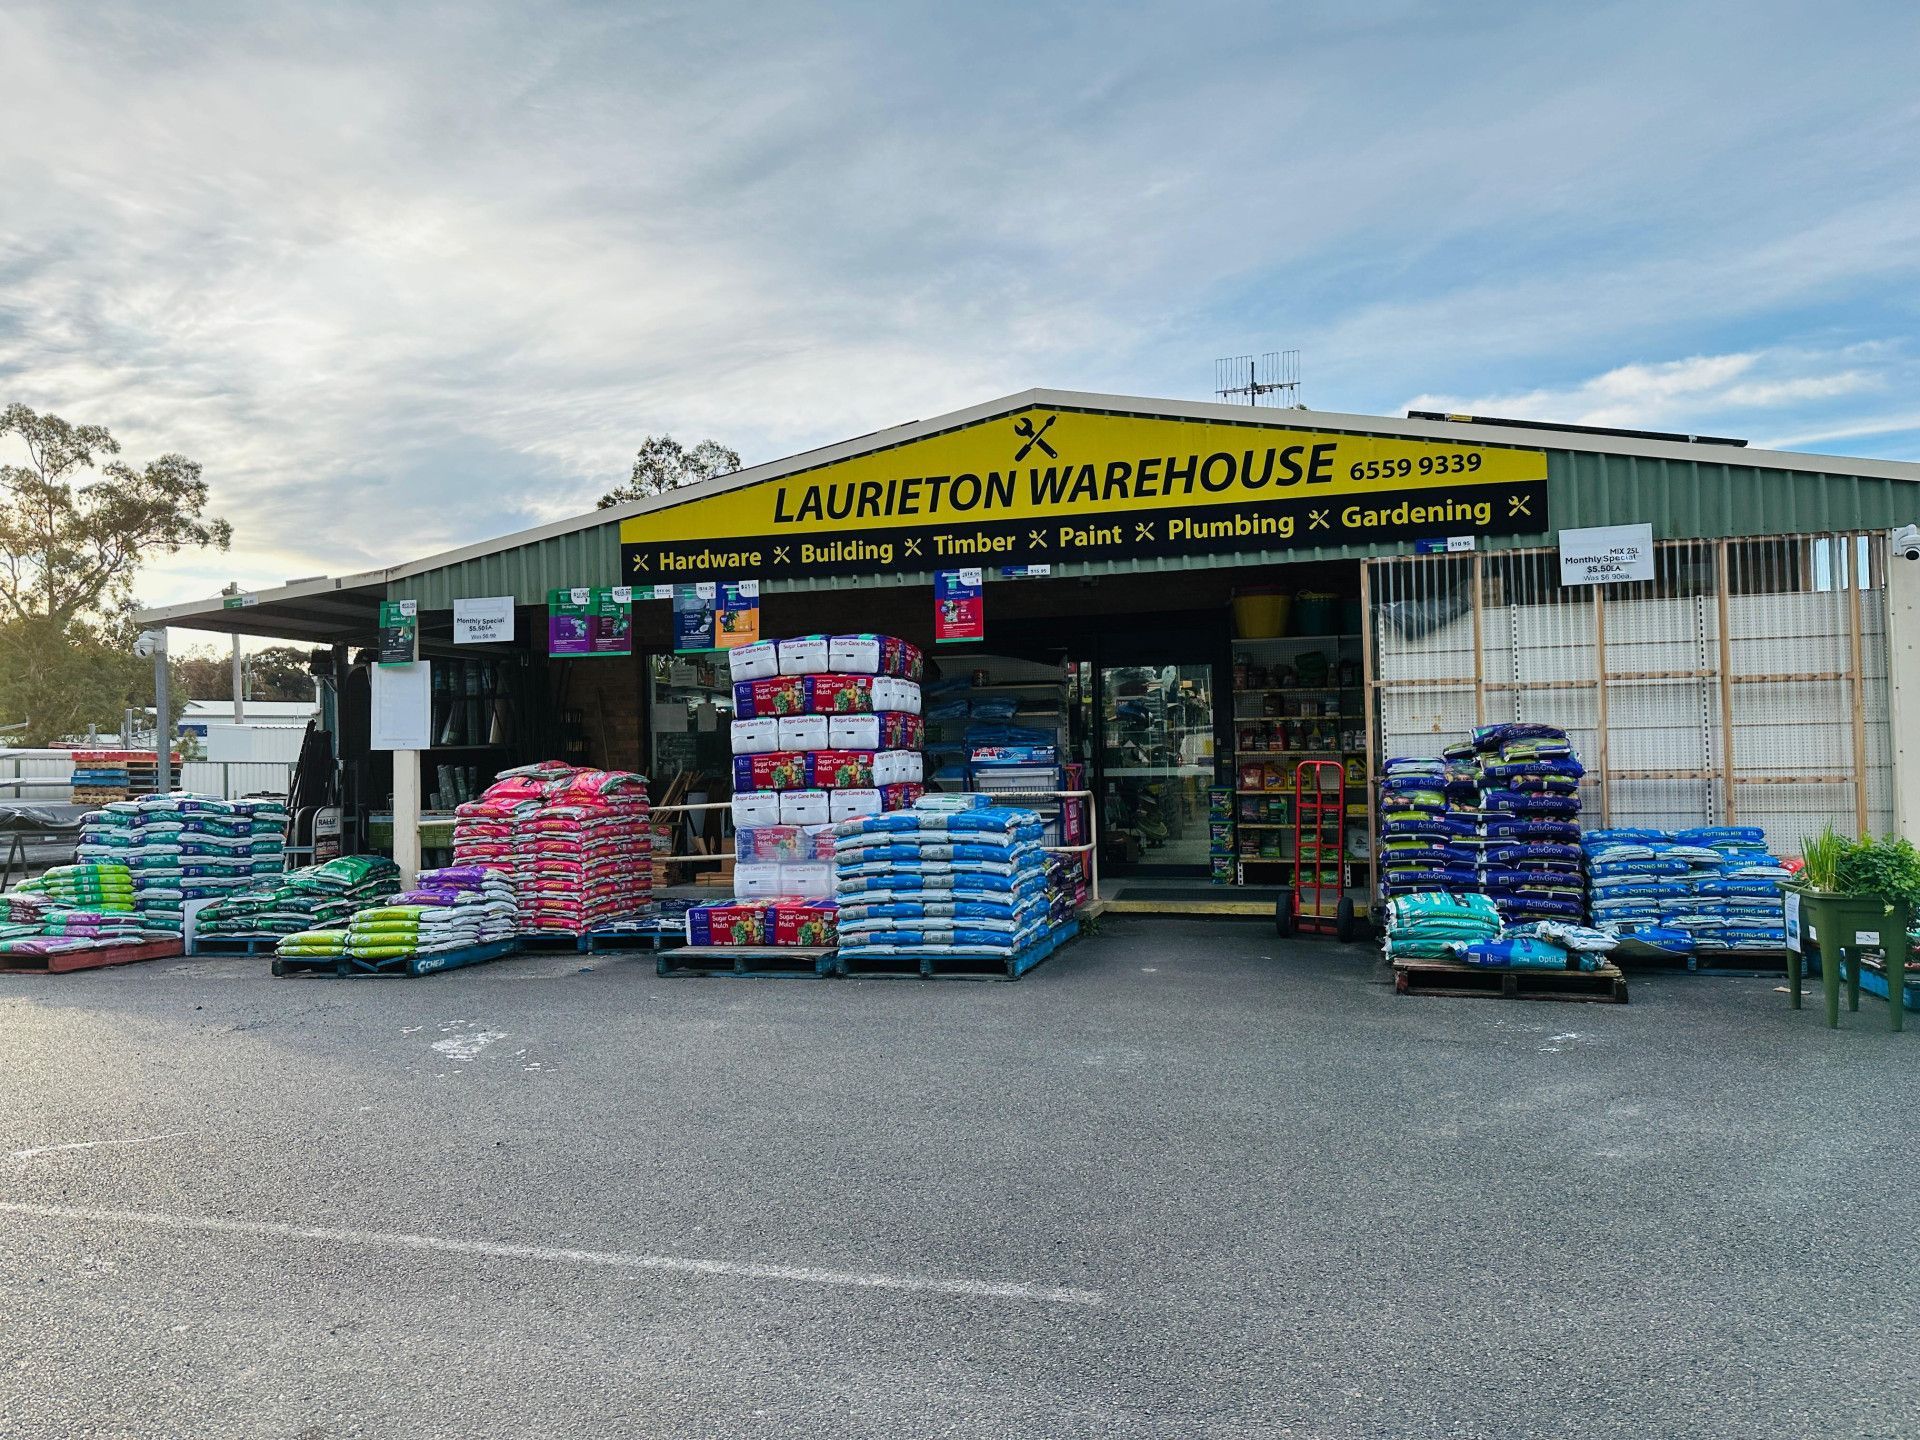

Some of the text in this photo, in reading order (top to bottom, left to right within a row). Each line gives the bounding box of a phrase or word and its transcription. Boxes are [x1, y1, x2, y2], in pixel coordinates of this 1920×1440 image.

[1349, 452, 1483, 481] 6559 9339
[773, 443, 1337, 523] LAURIETON WAREHOUSE
[1341, 498, 1491, 527] Gardening
[1059, 526, 1122, 548] Paint
[1168, 513, 1295, 540] Plumbing
[801, 541, 893, 566] Building
[933, 534, 1016, 556] Timber
[659, 549, 762, 571] Hardware
[1565, 554, 1637, 565] Monthly Special
[1417, 822, 1451, 831] ActivGrow
[1417, 850, 1451, 859] ActivGrow
[1527, 846, 1563, 854] ActivGrow
[1417, 872, 1452, 881] ActivGrow
[1526, 900, 1563, 909] ActivGrow
[1538, 955, 1567, 963] OptiLaw
